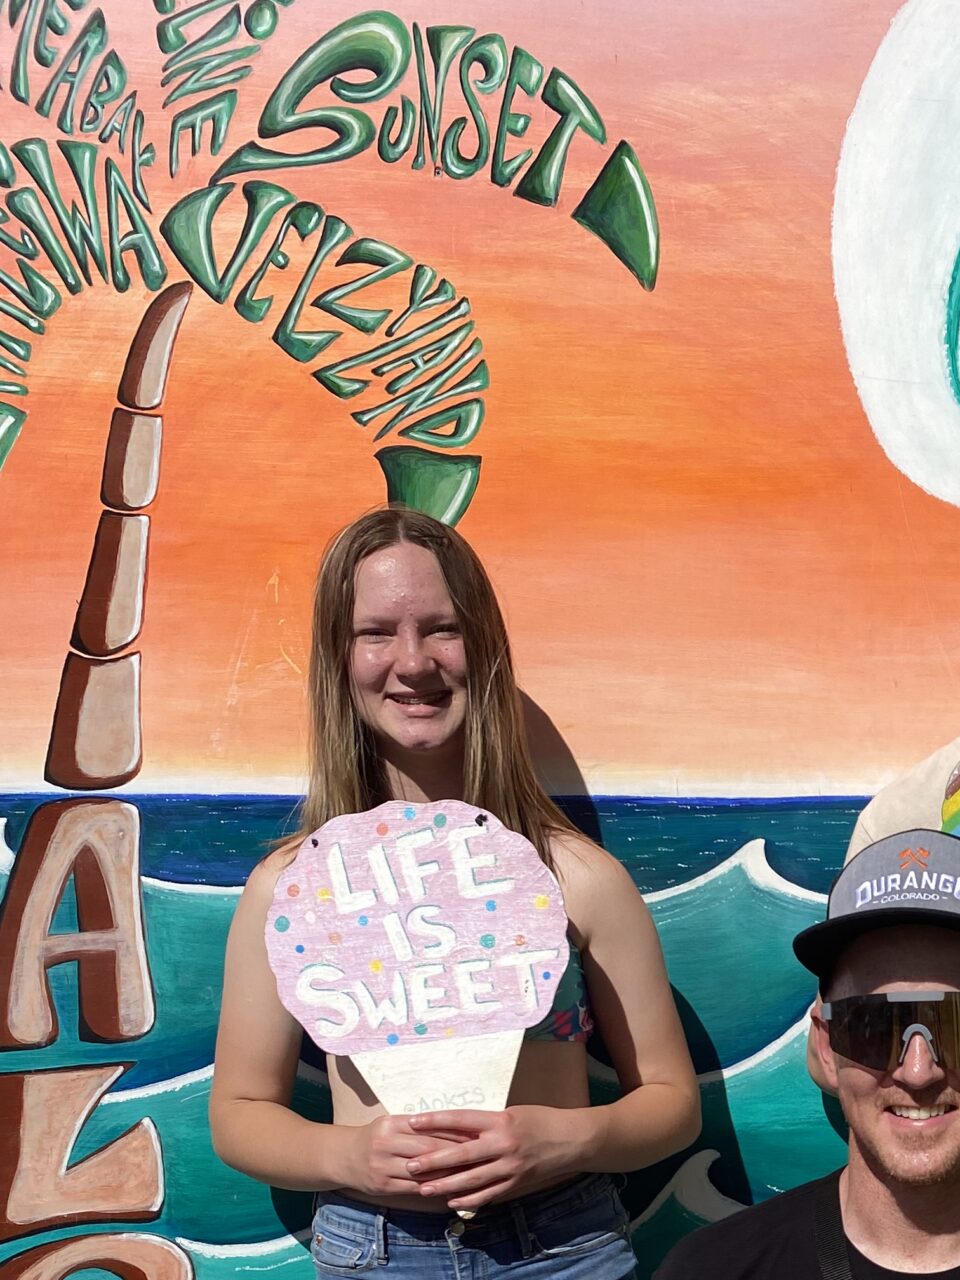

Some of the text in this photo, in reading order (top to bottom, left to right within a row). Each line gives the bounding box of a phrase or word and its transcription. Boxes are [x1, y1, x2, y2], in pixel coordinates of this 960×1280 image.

[208, 9, 607, 208] SUNSET
[159, 180, 490, 450] VELZYLAND
[326, 825, 516, 915] LIFE
[881, 892, 940, 905] COLORADO
[382, 904, 458, 962] IS
[295, 948, 561, 1039] SWEET
